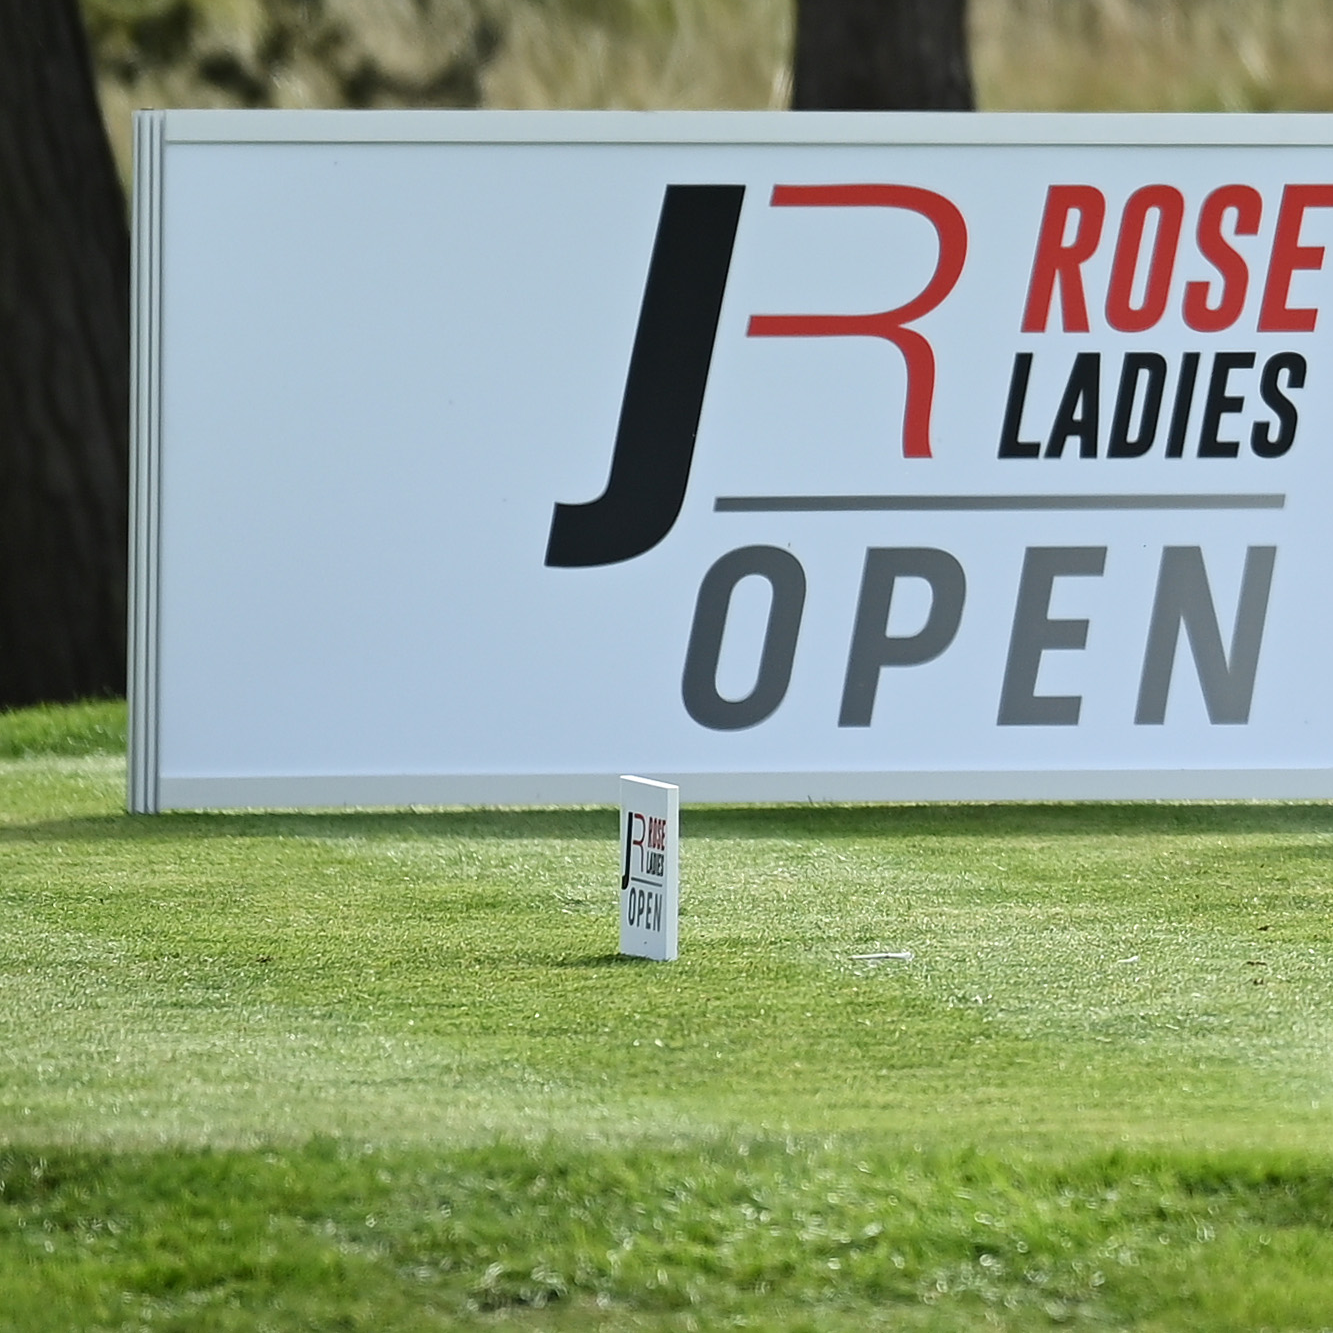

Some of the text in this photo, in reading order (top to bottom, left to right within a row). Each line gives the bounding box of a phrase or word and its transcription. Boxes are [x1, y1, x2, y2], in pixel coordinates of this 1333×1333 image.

[997, 351, 1308, 459] LADIES
[681, 543, 1278, 732] OPEN
[647, 816, 667, 851] ROSE
[646, 850, 664, 878] LADIES
[627, 886, 663, 933] OPEN
